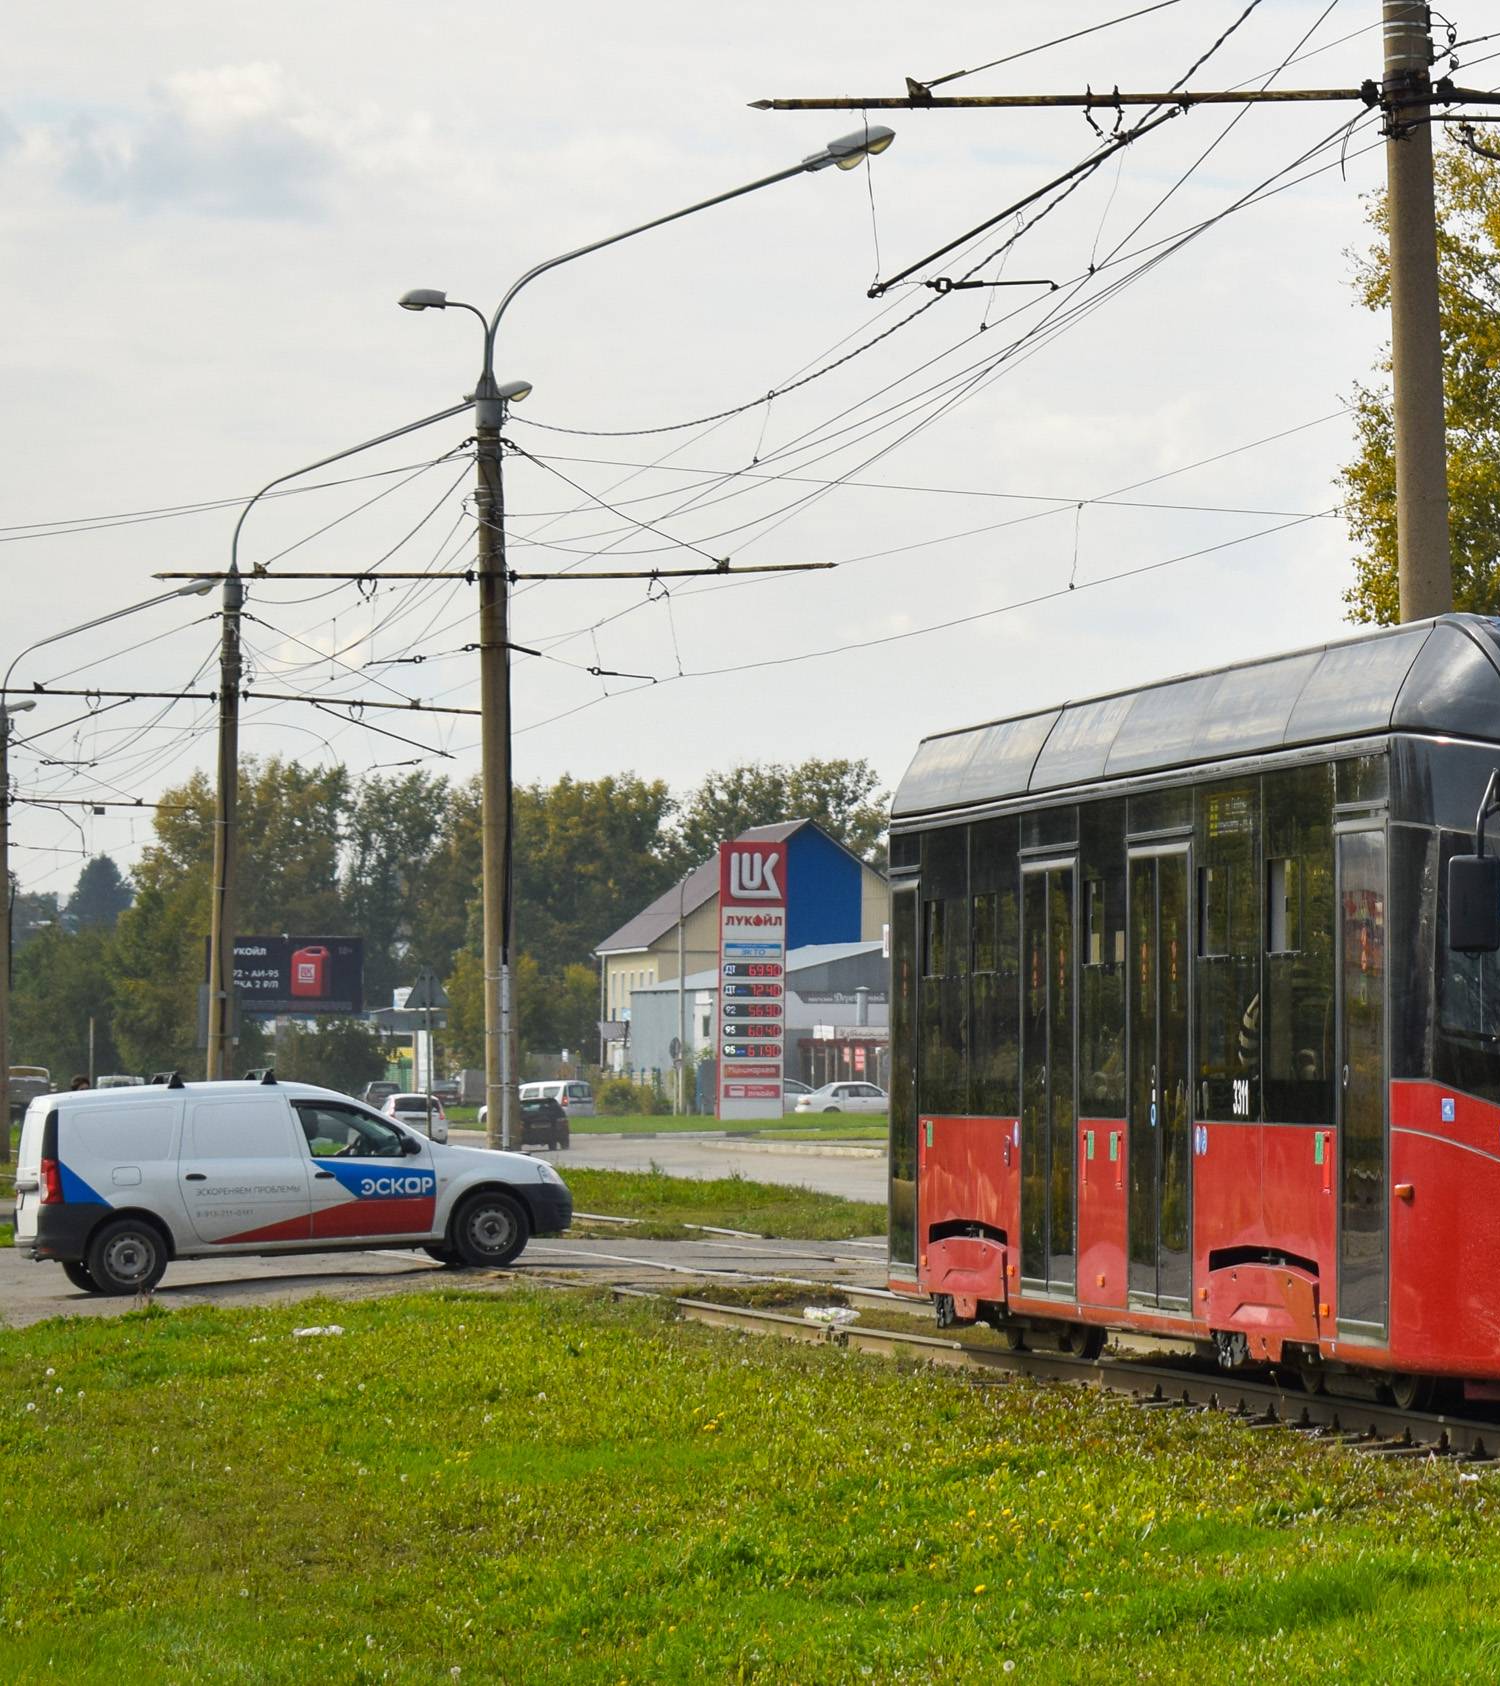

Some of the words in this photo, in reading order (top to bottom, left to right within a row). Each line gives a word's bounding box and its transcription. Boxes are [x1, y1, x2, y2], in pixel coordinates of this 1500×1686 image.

[725, 914, 782, 926] ЛУКОЙЛ
[233, 946, 267, 956] УКОЙЛ
[252, 970, 279, 978] АИ-95
[724, 965, 736, 975] ДТ
[725, 985, 736, 994] ДТ
[725, 1006, 736, 1014] 92
[725, 1026, 736, 1034] 95
[724, 1046, 736, 1054] 95
[1232, 1079, 1249, 1115] 3311
[254, 1185, 301, 1194] ПРОБЛЕМЫ
[361, 1177, 434, 1195] ЭСКОР
